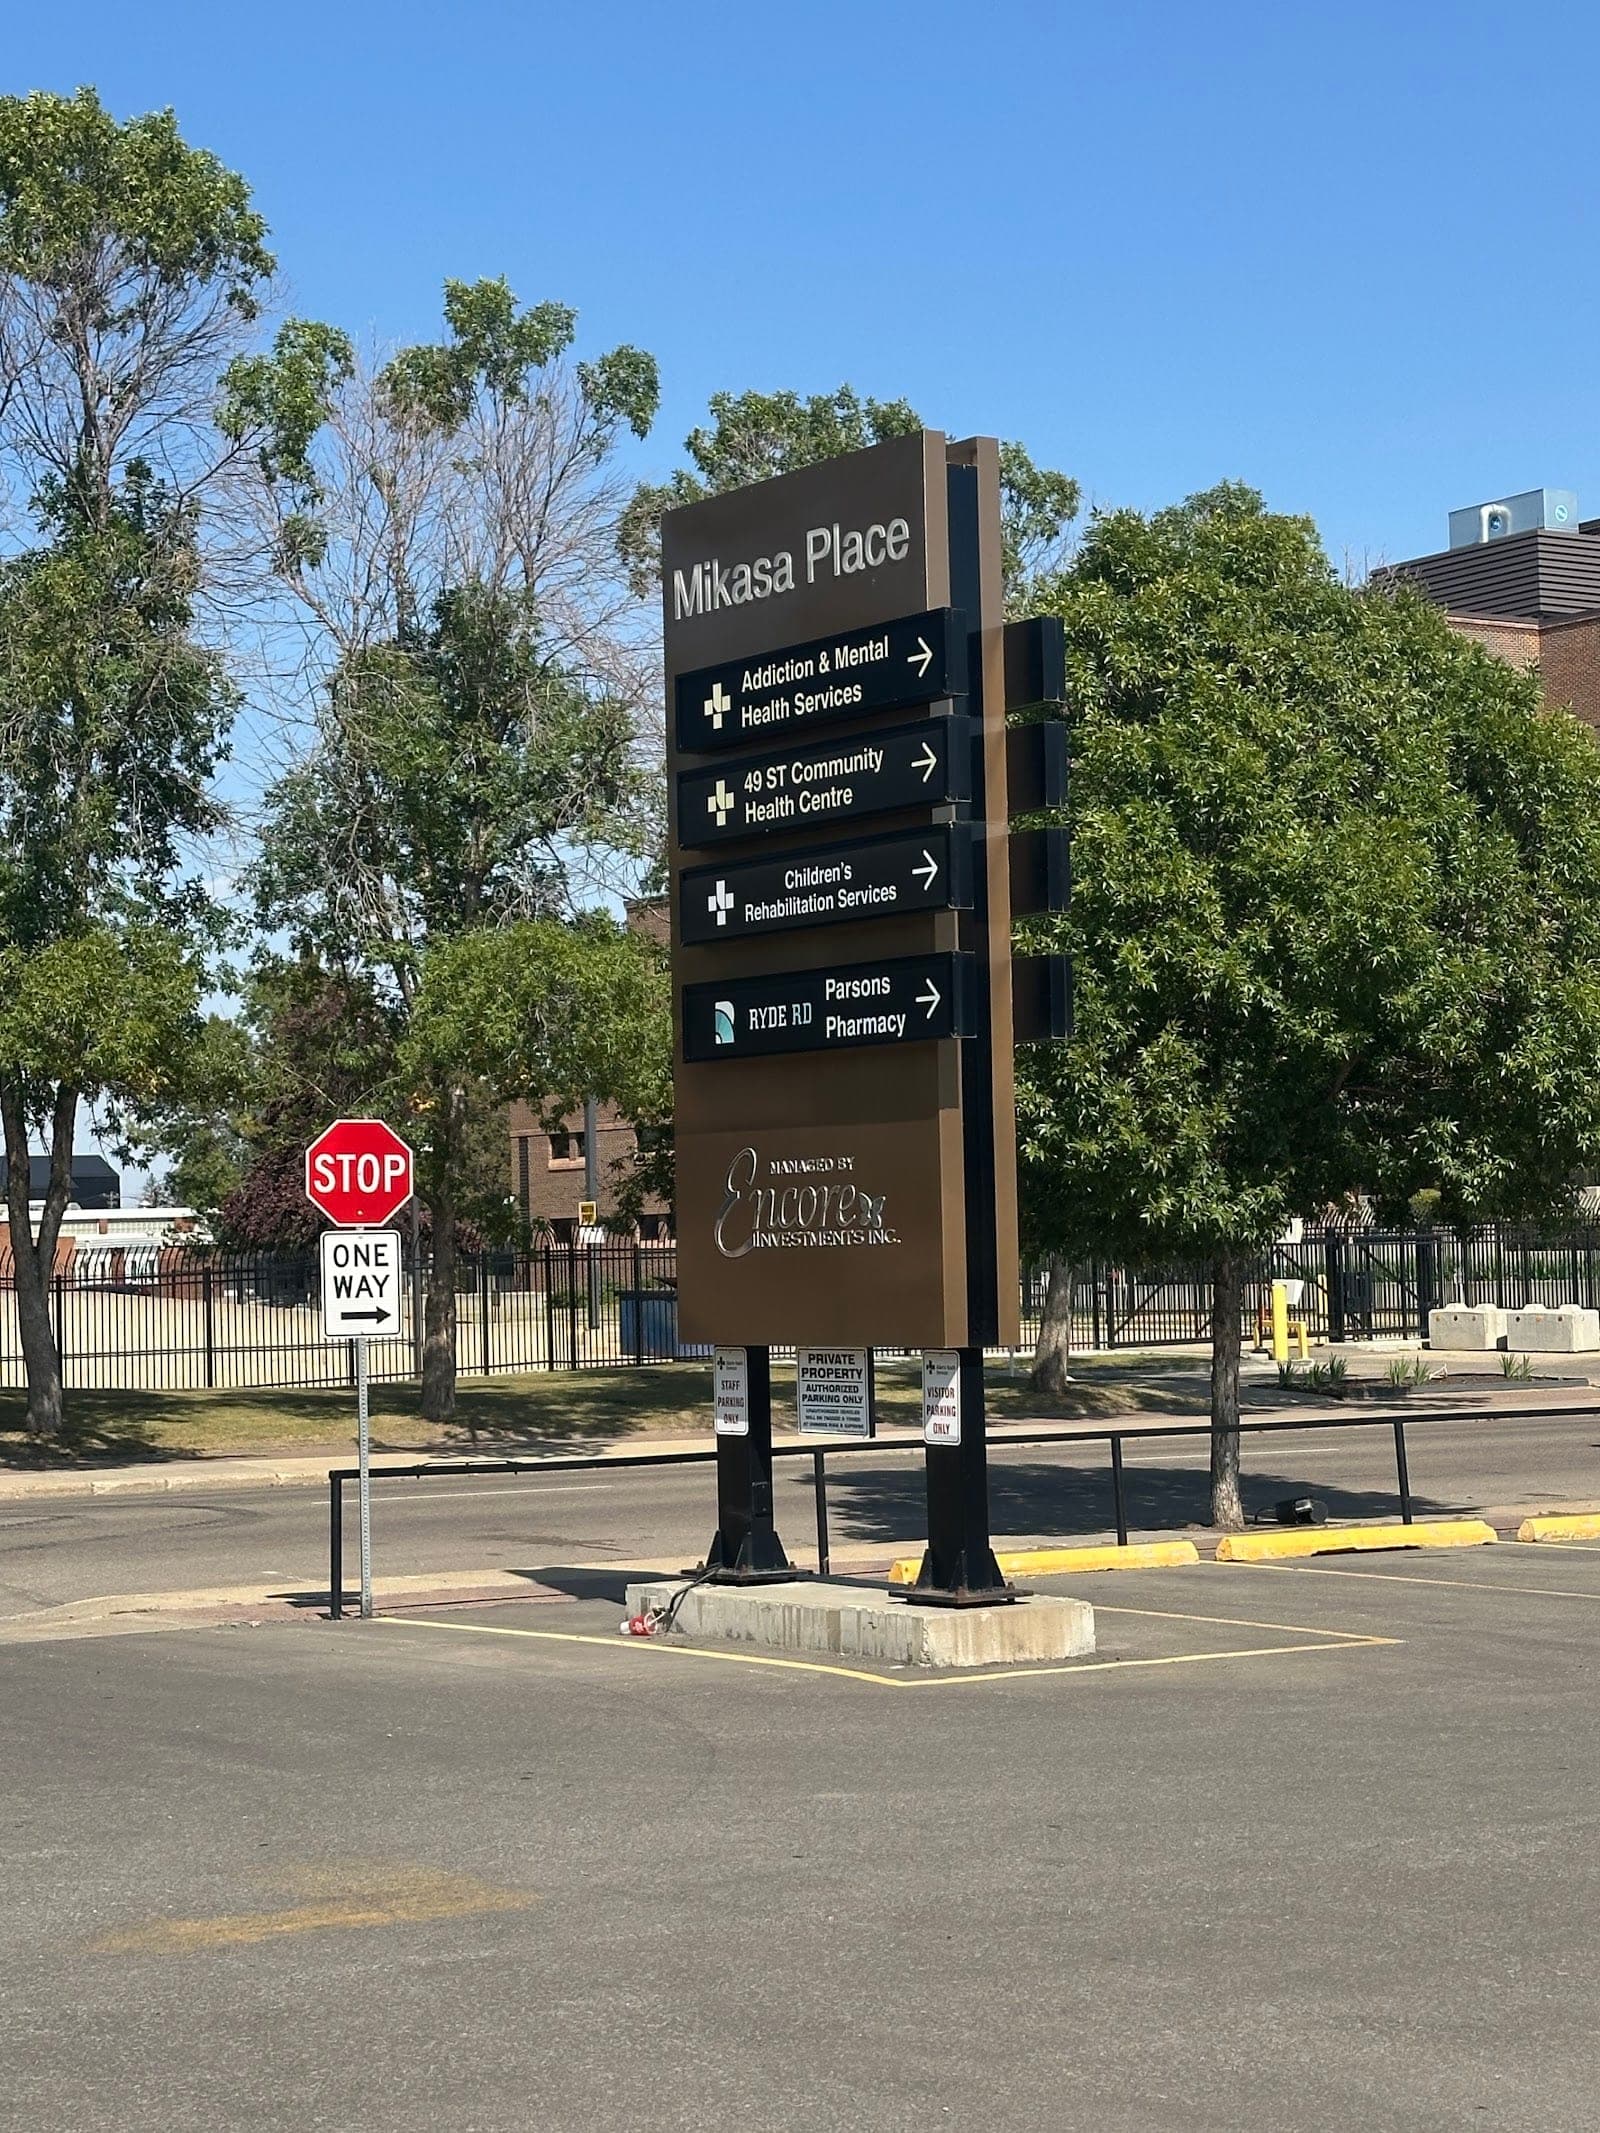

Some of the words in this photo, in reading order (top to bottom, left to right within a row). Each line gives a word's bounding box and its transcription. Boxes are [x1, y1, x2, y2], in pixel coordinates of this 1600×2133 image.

[673, 551, 795, 620] Mikasa
[806, 517, 910, 584] Place
[741, 656, 814, 693] Addiction
[819, 652, 831, 674] &
[835, 635, 889, 669] Mental
[741, 699, 790, 728] Health
[794, 682, 862, 715] Services
[744, 769, 762, 794] 49
[766, 764, 787, 789] ST
[791, 747, 884, 783] Community
[745, 795, 795, 824] Health
[799, 785, 853, 814] Centre
[784, 862, 852, 889] Children's
[744, 892, 834, 923] Rehabilitation
[837, 884, 897, 908] Services
[825, 976, 891, 1001] Parsons
[749, 1004, 787, 1031] RYDE
[791, 1002, 812, 1026] RD
[826, 1012, 906, 1039] Pharmacy
[313, 1153, 406, 1194] STOP
[770, 1157, 834, 1175] MANAGED
[837, 1156, 855, 1171] BY
[714, 1147, 857, 1258] Encore
[752, 1229, 865, 1248] INVESTMENTS
[868, 1228, 902, 1245] INC.
[333, 1243, 389, 1268] ONE
[333, 1274, 391, 1299] WAY
[808, 1353, 856, 1365] PRIVATE
[721, 1380, 740, 1390] STAFF
[801, 1367, 863, 1379] PROPERTY
[802, 1393, 840, 1403] PARKING
[842, 1395, 864, 1404] ONLY
[806, 1383, 859, 1393] AUTHORIZED
[927, 1386, 955, 1398] VISITOR
[717, 1396, 744, 1408] PARKING
[926, 1404, 956, 1417] PARKING
[723, 1413, 739, 1424] ONLY
[932, 1422, 950, 1435] ONLY
